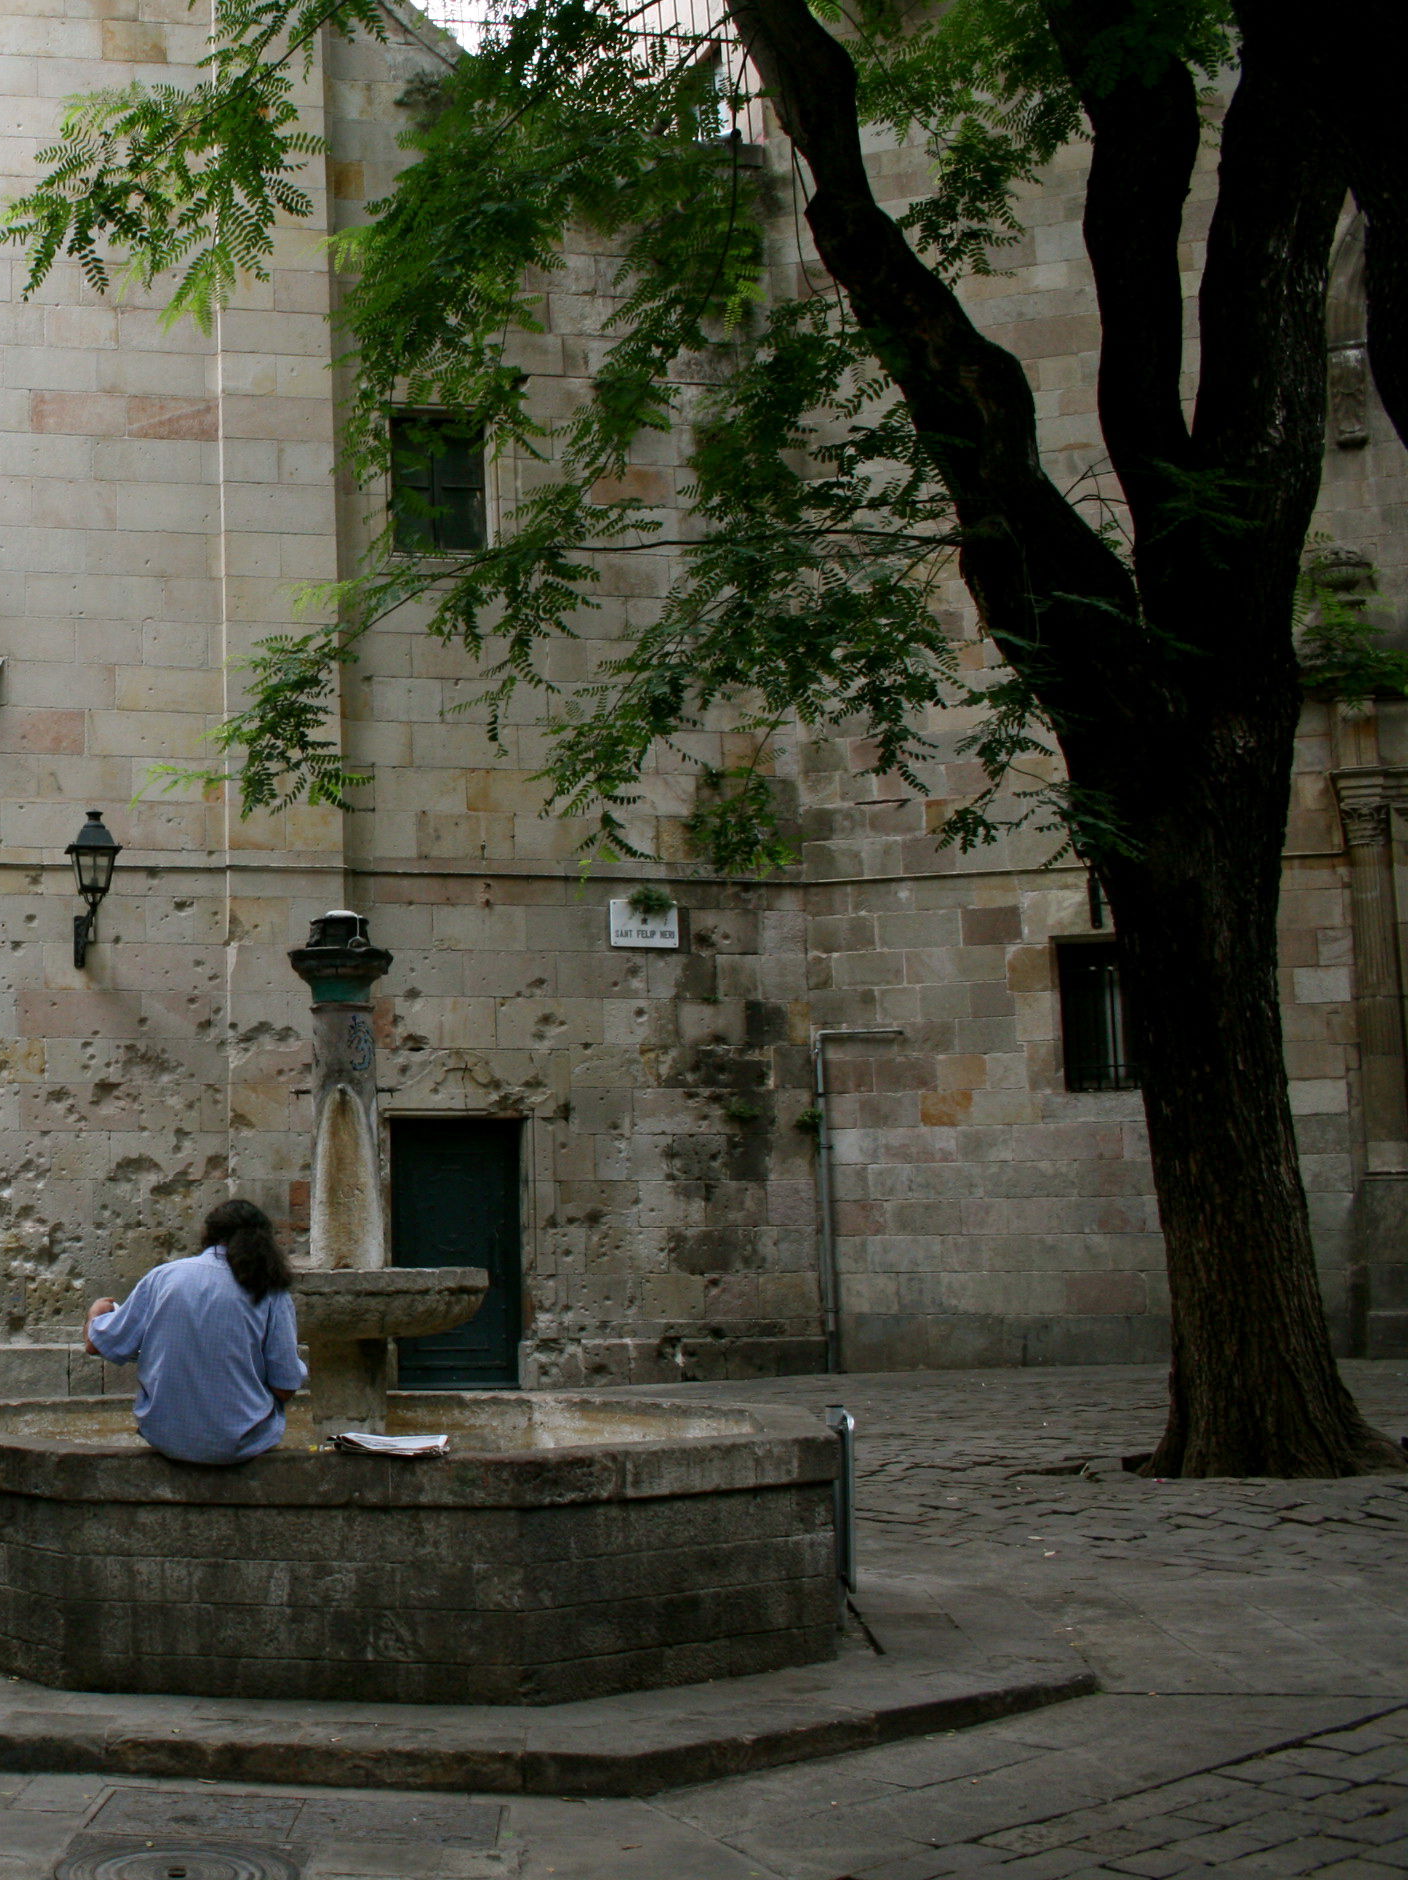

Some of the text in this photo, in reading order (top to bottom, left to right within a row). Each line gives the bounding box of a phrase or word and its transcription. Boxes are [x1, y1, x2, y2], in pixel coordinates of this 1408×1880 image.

[615, 929, 675, 939] SANT FELIP NERI
